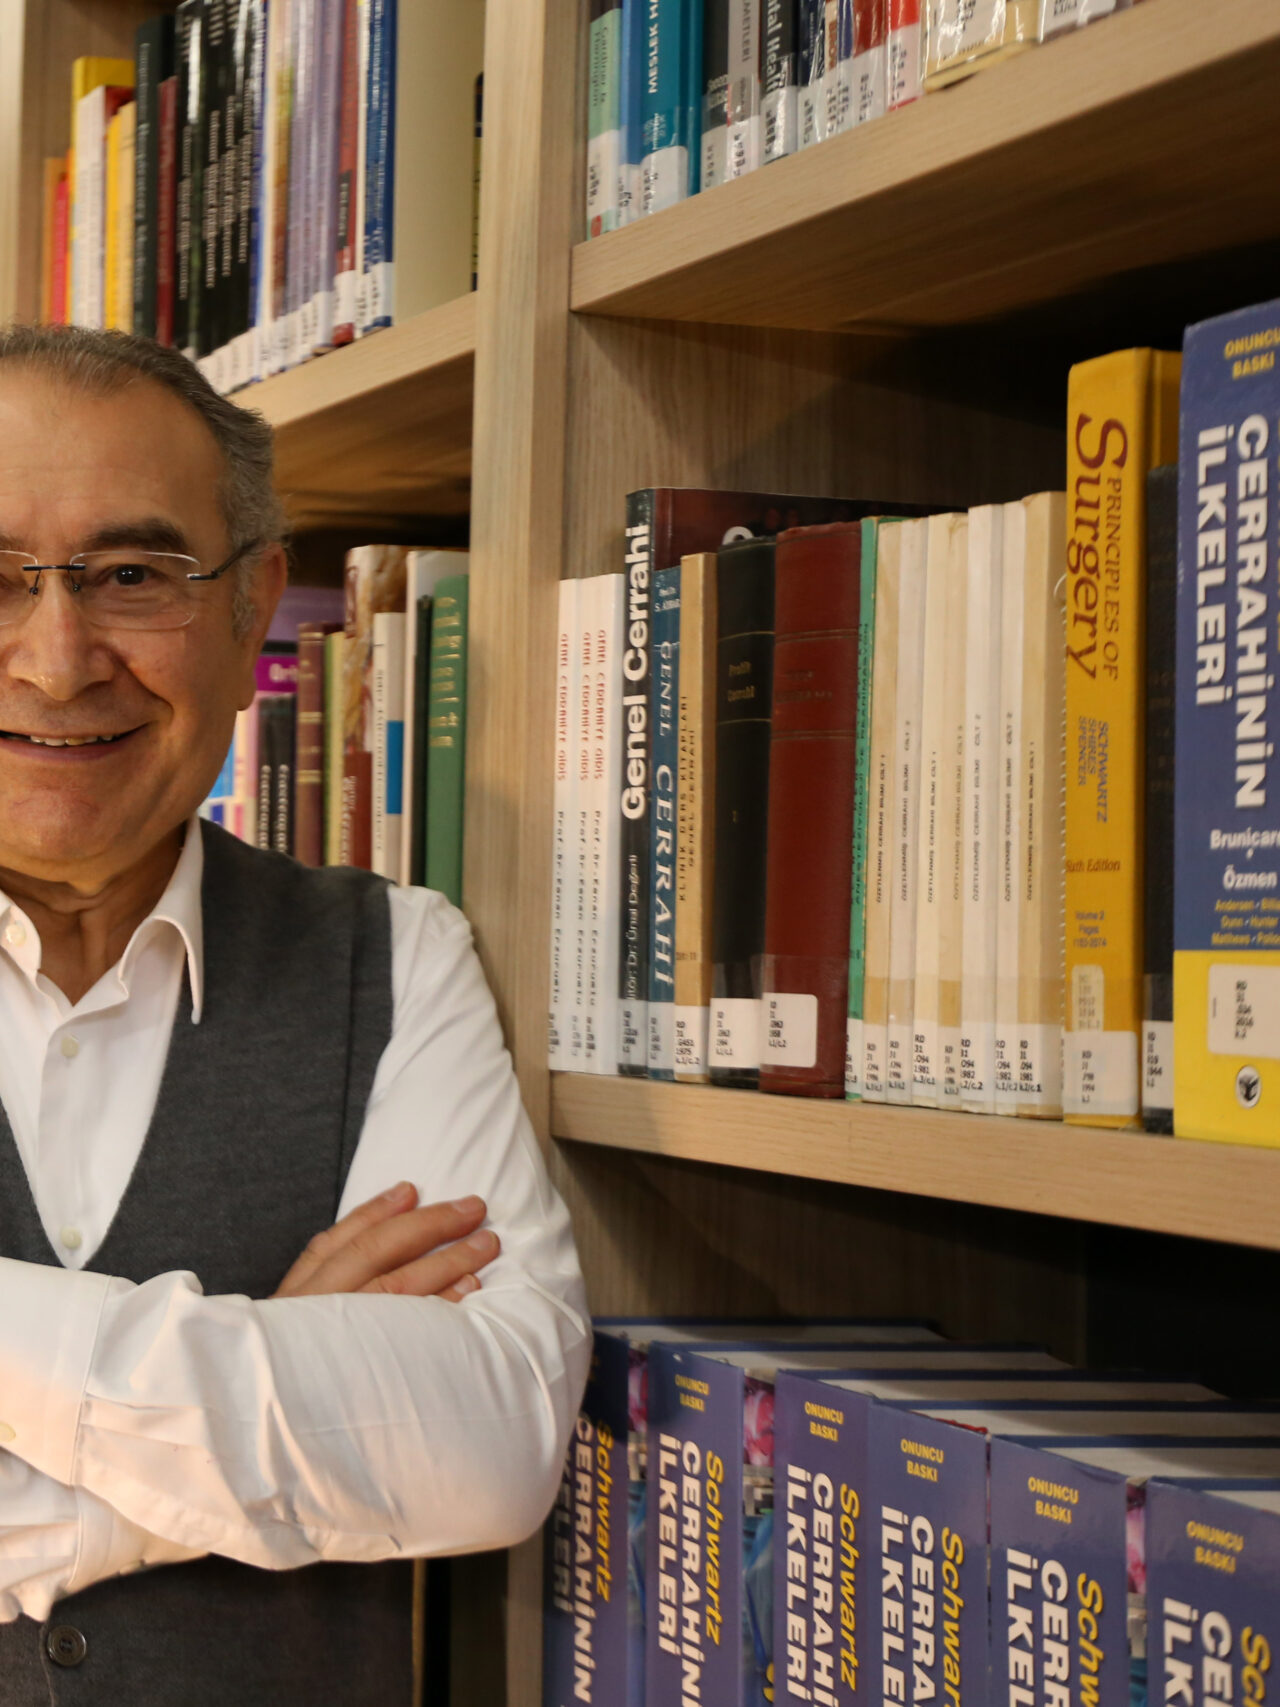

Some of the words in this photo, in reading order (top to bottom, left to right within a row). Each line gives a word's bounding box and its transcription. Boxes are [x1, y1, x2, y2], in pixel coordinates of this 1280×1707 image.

[648, 23, 659, 94] MESLEK
[1233, 351, 1276, 380] BASKI
[622, 523, 650, 682] Cerrahi
[1066, 412, 1128, 681] Surgery
[1103, 476, 1121, 634] PRINCIPLES
[1195, 423, 1234, 706] İLKELERİ
[1235, 413, 1274, 808] CERRAHİNİN
[659, 640, 673, 737] GENEL
[1103, 641, 1118, 682] OF
[621, 694, 648, 820] Genel
[1096, 720, 1109, 824] SCHWARTZ
[654, 764, 675, 986] CERRAHİ
[1223, 864, 1278, 889] Özmen
[804, 1400, 844, 1425] ONUNCU
[809, 1421, 839, 1443] BASKI
[900, 1438, 945, 1464] ONUNCU
[906, 1459, 939, 1483] BASKI
[573, 1411, 596, 1705] CERRAHİNİN
[596, 1418, 613, 1604] Schwartz
[659, 1432, 683, 1656] İLKELERİ
[705, 1450, 725, 1647] Schwartz
[1027, 1476, 1080, 1505] ONUNCU
[1034, 1499, 1073, 1525] BASKI
[1186, 1520, 1245, 1553] ONUNCU
[1194, 1545, 1237, 1575] BASKI
[786, 1463, 813, 1701] İLKELERİ
[839, 1483, 861, 1692] Schwartz
[881, 1504, 909, 1707] İLKELE
[910, 1515, 937, 1707] CERRA
[941, 1526, 964, 1707] Schwar
